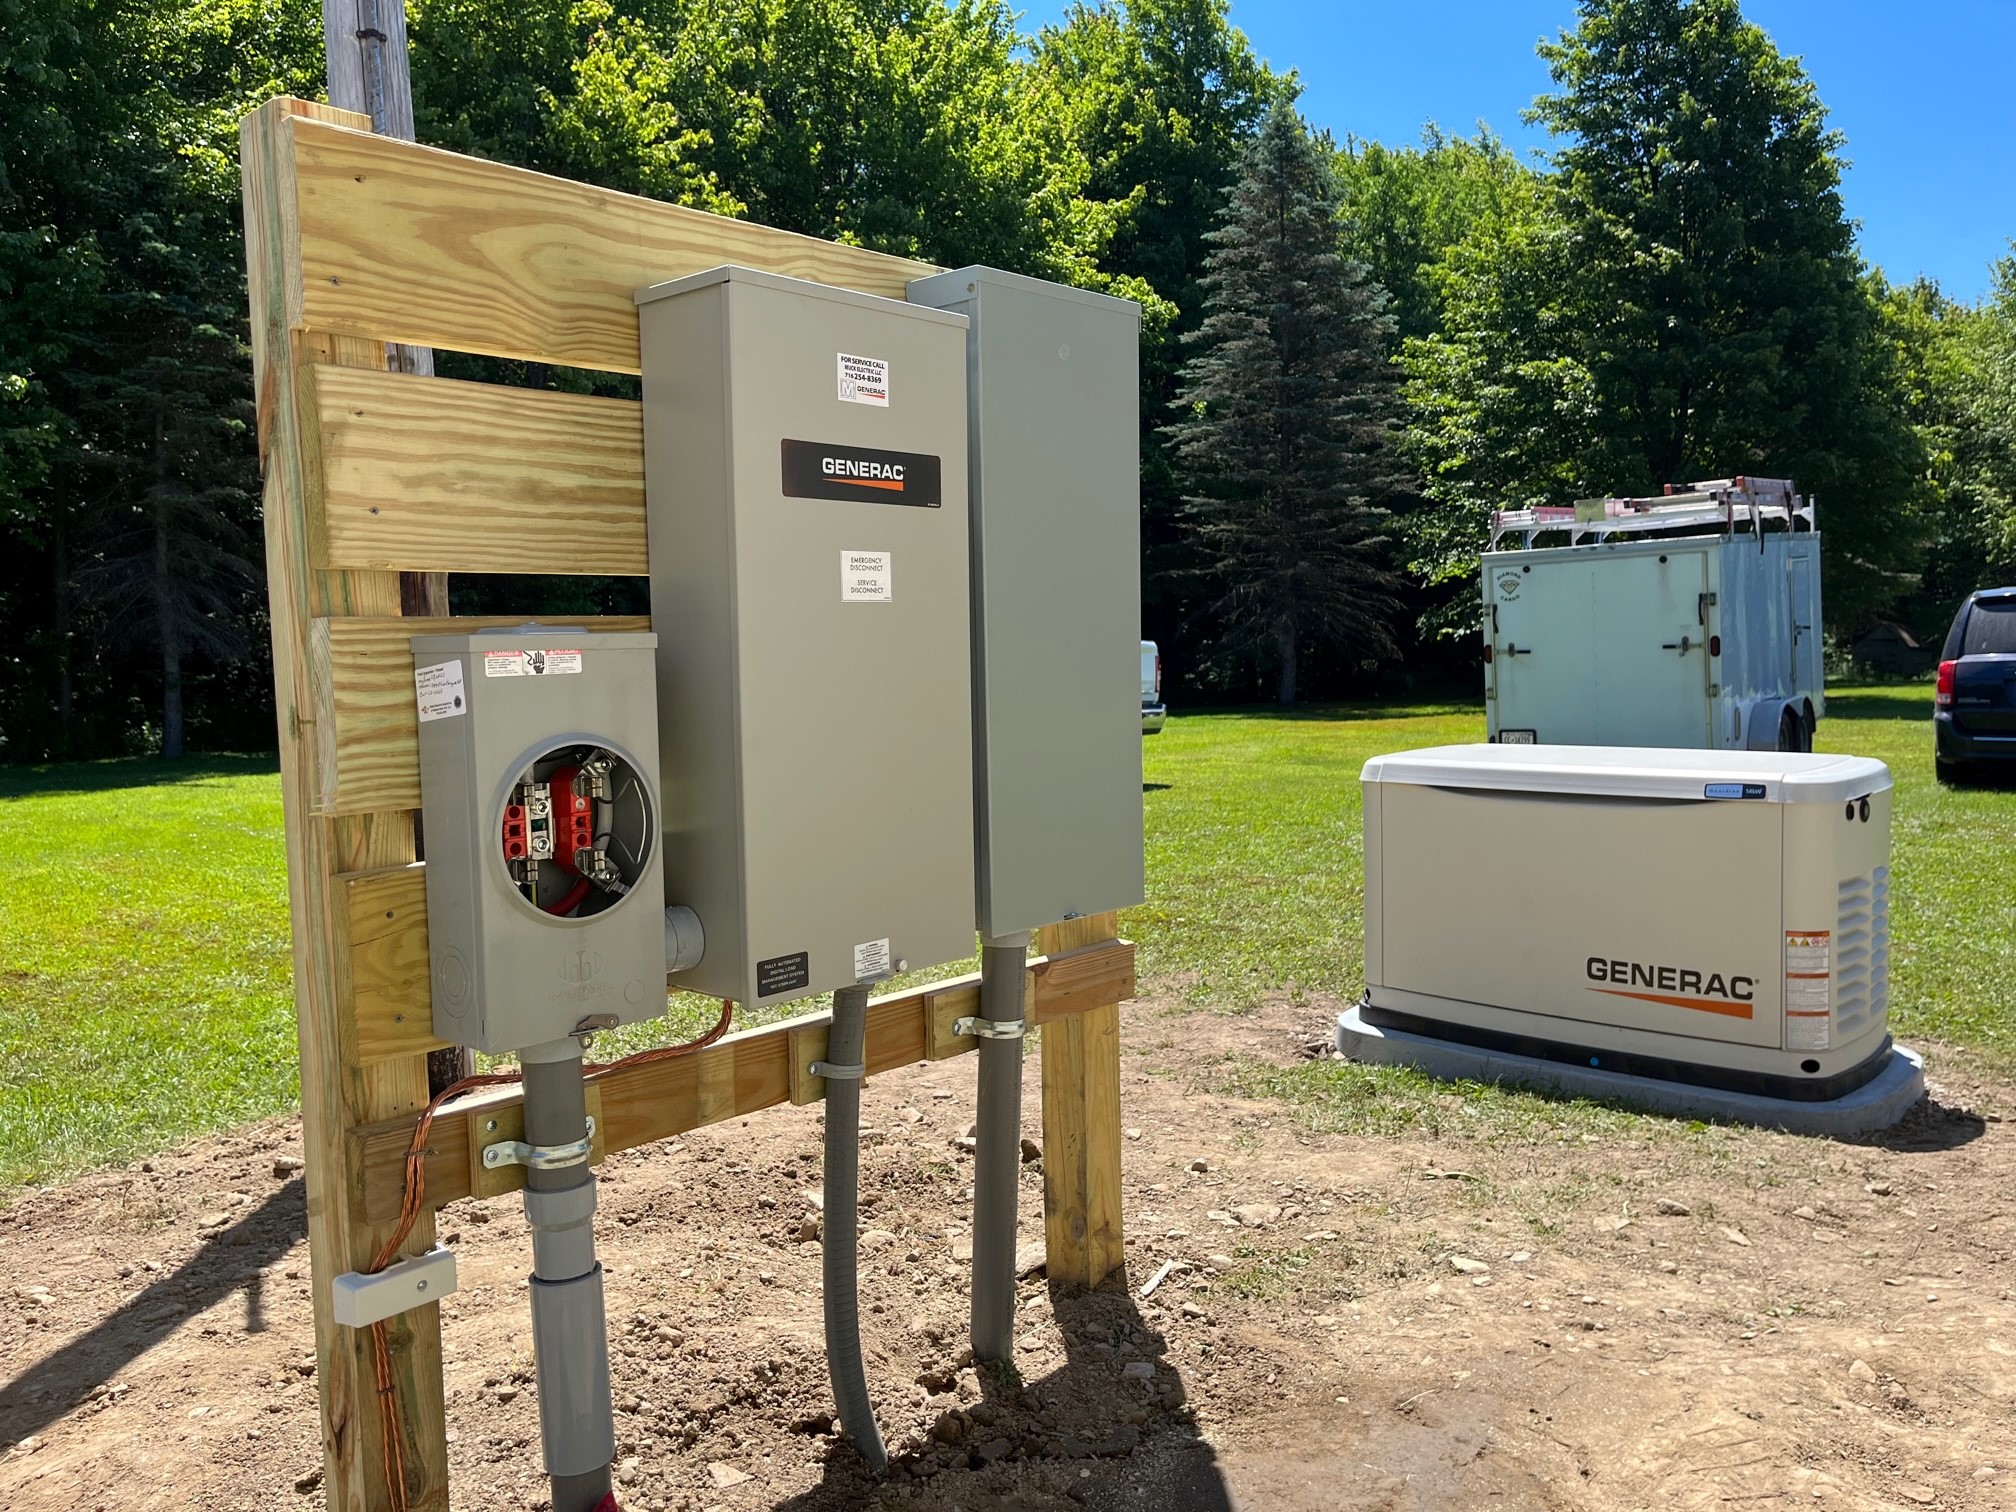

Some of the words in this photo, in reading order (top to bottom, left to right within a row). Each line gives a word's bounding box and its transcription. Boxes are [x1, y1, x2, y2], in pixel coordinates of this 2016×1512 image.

[852, 358, 872, 367] SERVICE
[857, 367, 874, 375] ELECTRIC
[857, 386, 886, 395] GENERAC
[822, 458, 904, 480] GENERAC
[1496, 572, 1521, 581] DIAMOND
[1500, 594, 1520, 602] CARGO
[778, 957, 802, 967] AUTOMATED
[762, 975, 789, 984] MANAGEMENT
[1586, 956, 1753, 1000] GENERAC
[778, 979, 797, 988] COMPLIANT
